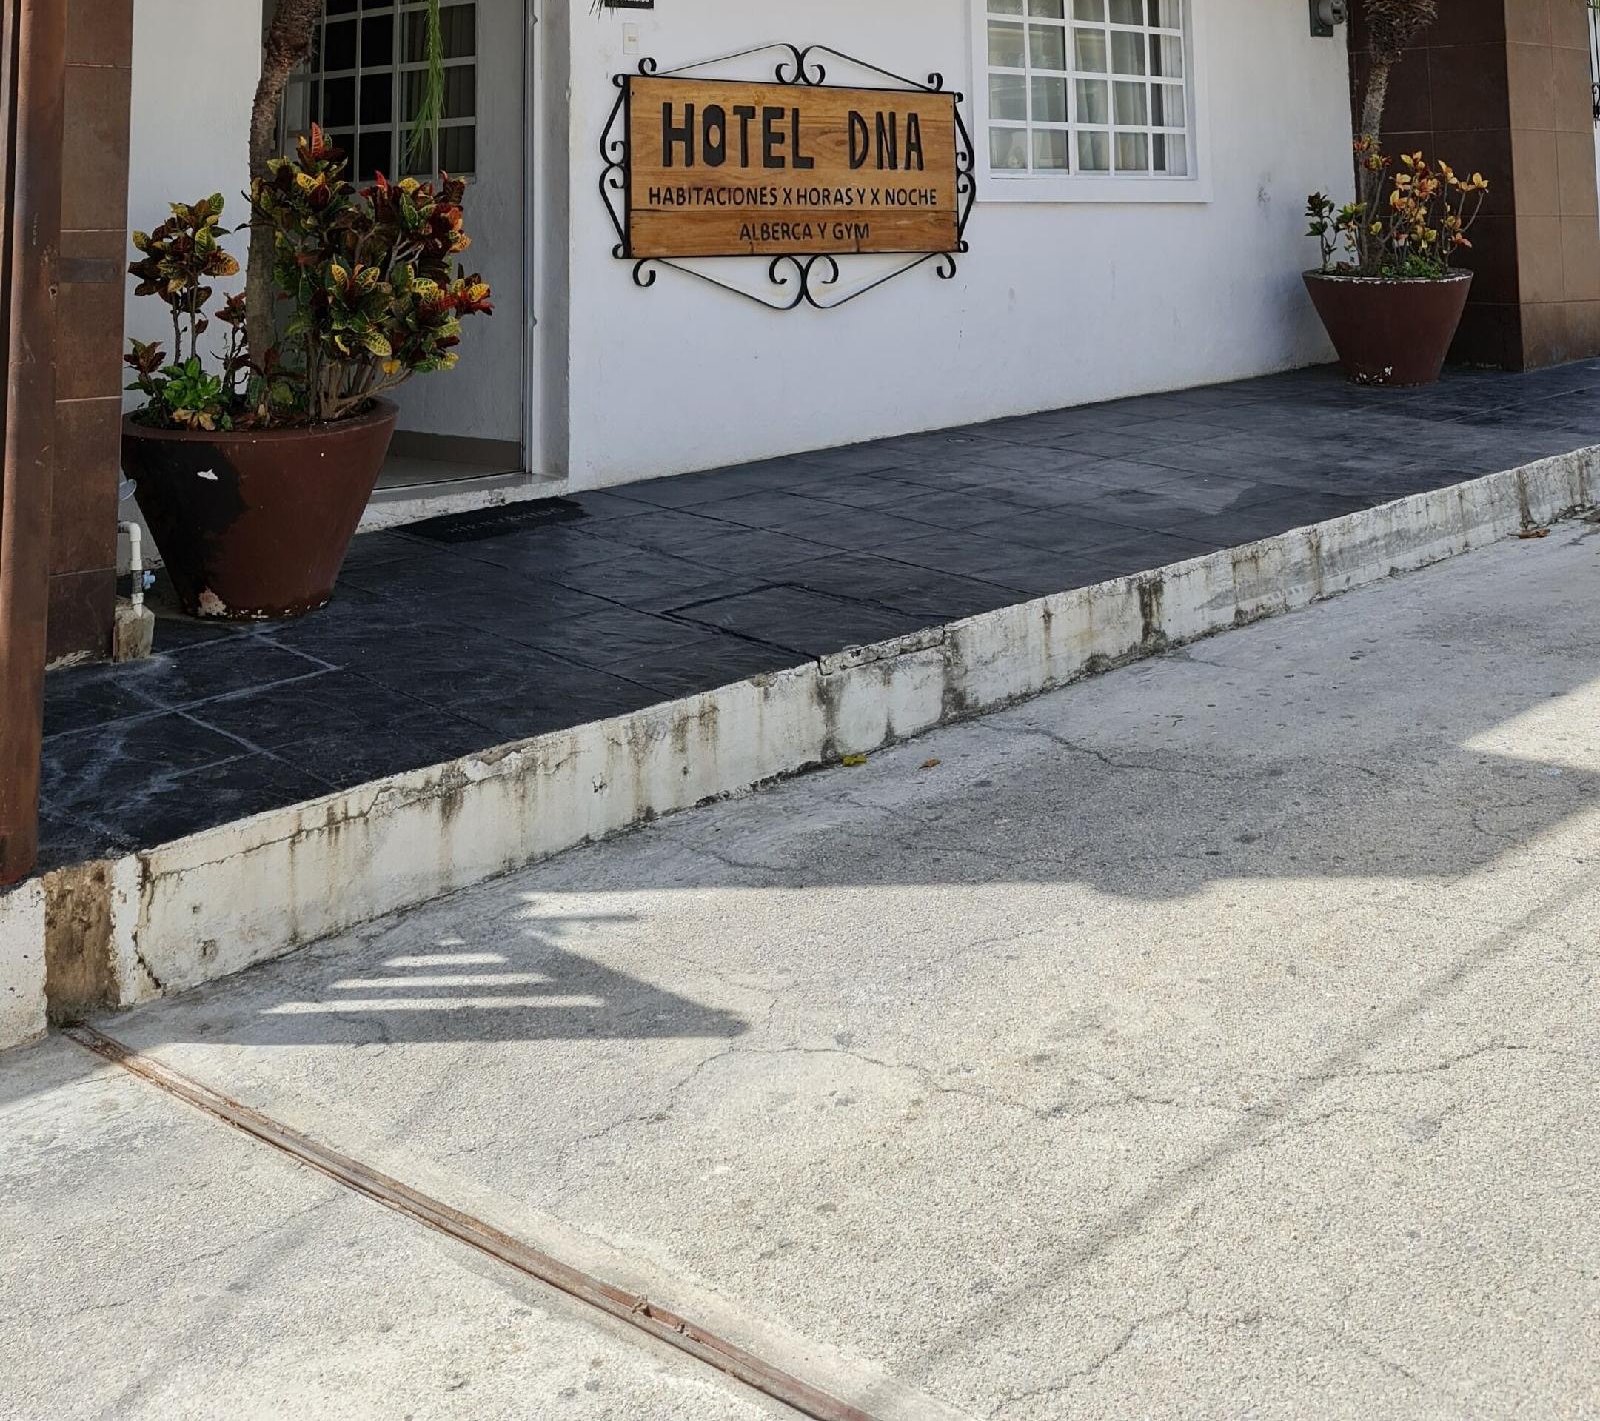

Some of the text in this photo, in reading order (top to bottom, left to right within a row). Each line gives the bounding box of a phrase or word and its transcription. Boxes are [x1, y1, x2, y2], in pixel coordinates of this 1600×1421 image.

[662, 101, 925, 171] HOTEL DNA
[648, 186, 938, 206] HABITACIONES X HORAS Y X NOCHE
[739, 223, 870, 241] ALBERCA Y GYM
